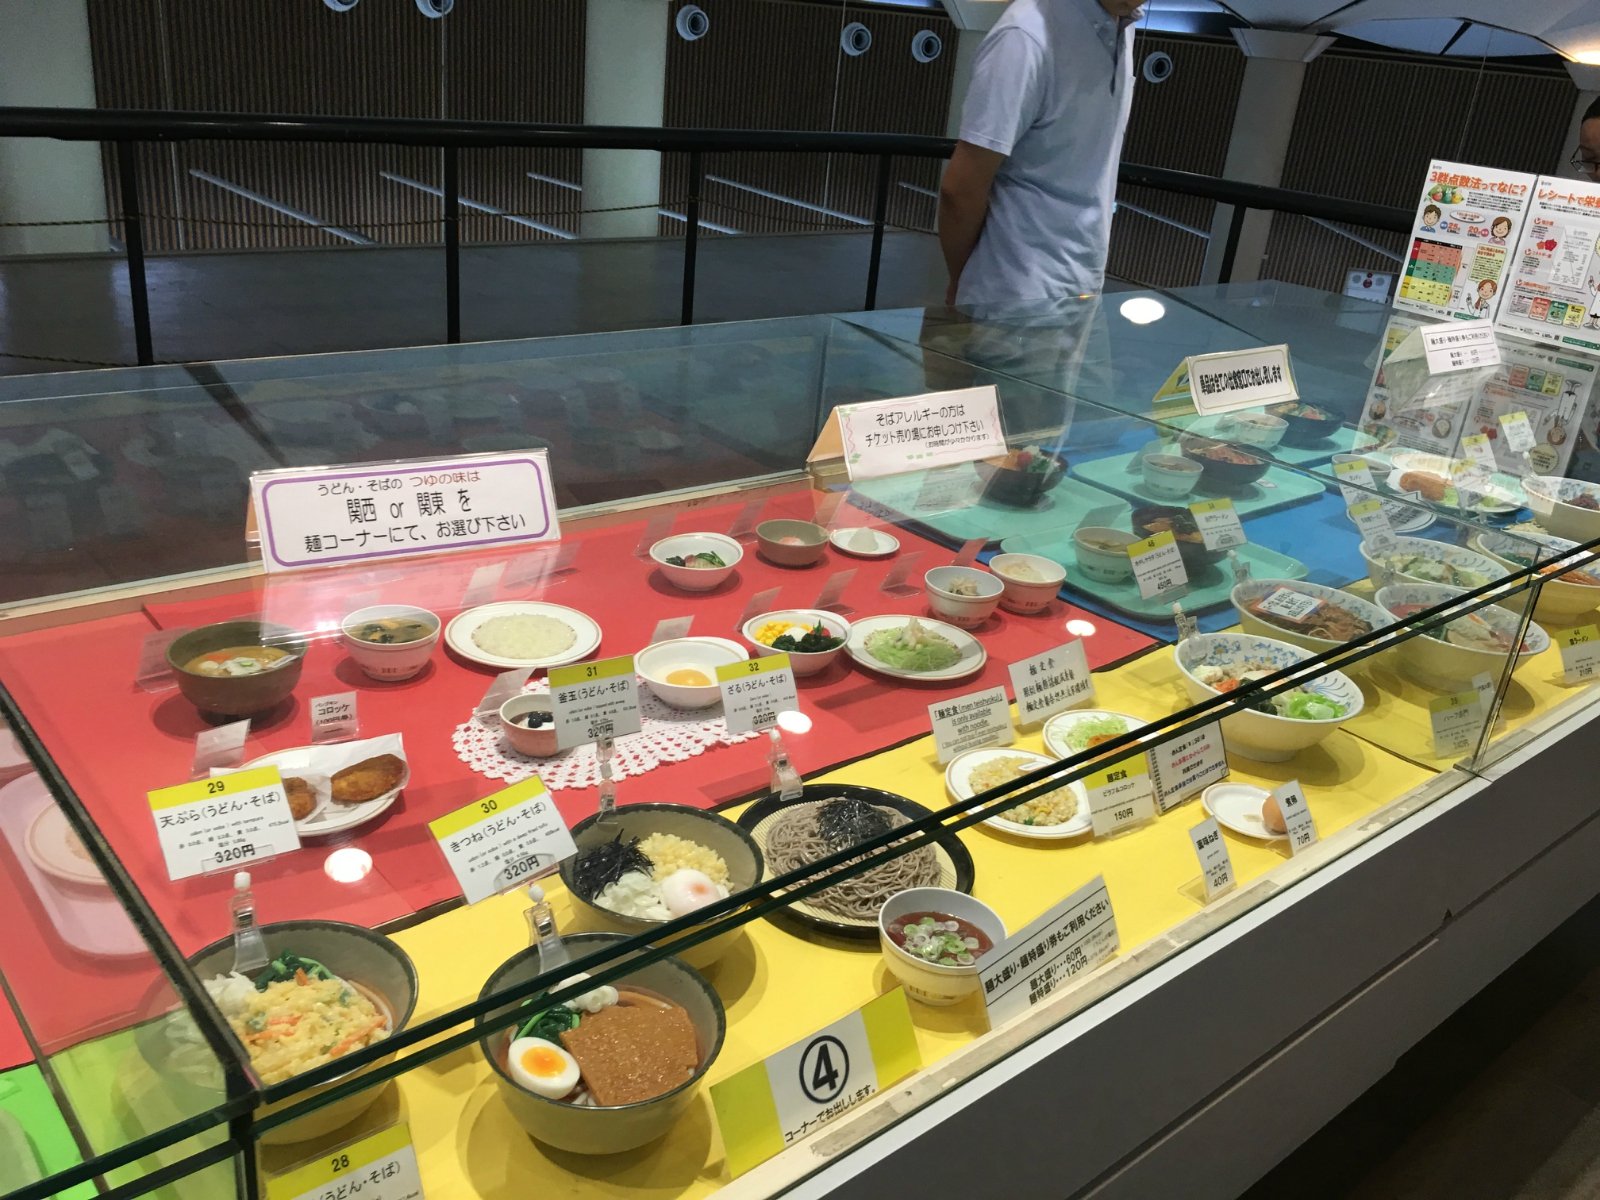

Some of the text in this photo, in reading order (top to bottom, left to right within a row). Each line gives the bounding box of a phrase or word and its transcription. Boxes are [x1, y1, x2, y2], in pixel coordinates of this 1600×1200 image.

[876, 404, 965, 426] そばアレルギーの方は
[317, 470, 480, 497] うどん・そばの つゆの味は
[346, 488, 472, 524] 関西 or 関東 を
[586, 666, 598, 677] 31
[748, 662, 760, 672] 32
[318, 704, 350, 715] コロッケ
[207, 780, 226, 794] 29
[159, 791, 281, 829] 天ぷら(うどん・そば)
[481, 799, 498, 814] 30
[1114, 807, 1134, 821] 150円
[450, 801, 547, 853] きつね(うどん・そば)
[1297, 832, 1310, 845] 70円
[215, 843, 256, 864] 320円
[504, 855, 540, 880] 320円
[1214, 871, 1228, 887] 40円
[785, 1083, 876, 1143] コーナーでお出しします。
[331, 1154, 350, 1172] 28
